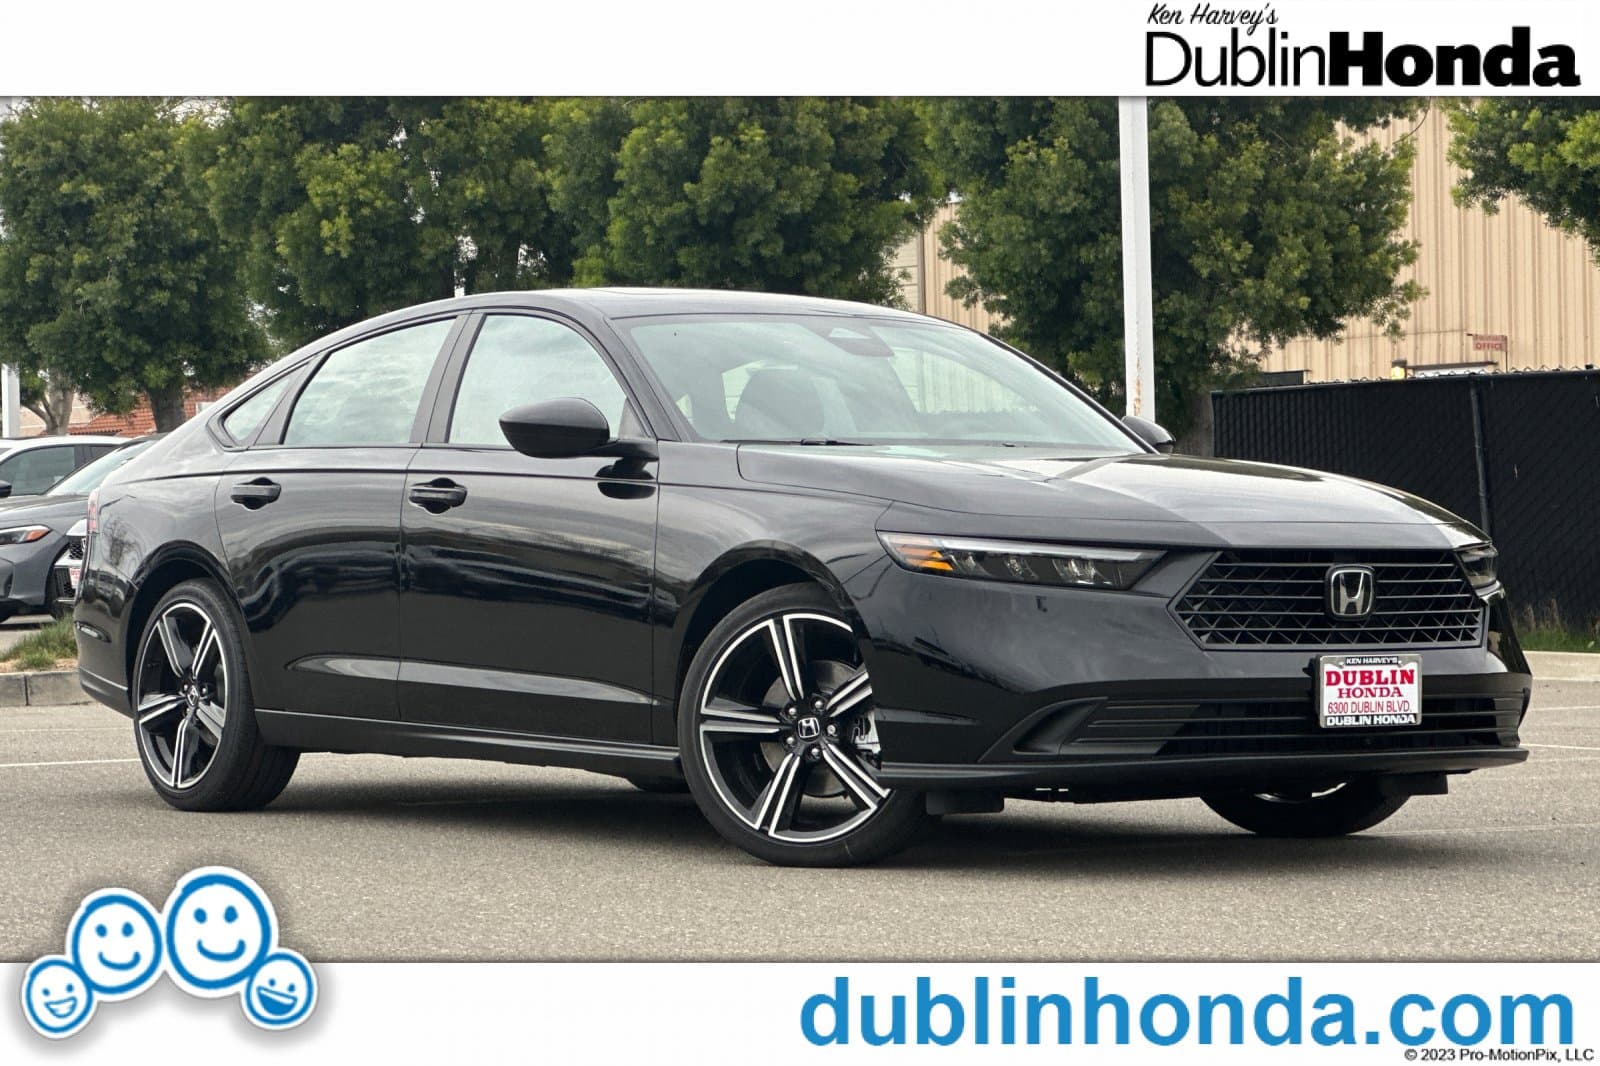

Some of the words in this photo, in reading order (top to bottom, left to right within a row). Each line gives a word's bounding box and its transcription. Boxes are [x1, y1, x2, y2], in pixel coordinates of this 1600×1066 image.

[1346, 657, 1362, 665] KEN
[1363, 656, 1398, 665] HARVEY'S
[1325, 669, 1415, 686] DUBLIN
[1337, 687, 1404, 699] HONDA
[1328, 702, 1349, 714] 6300
[1351, 701, 1385, 714] DUBLIN
[1386, 700, 1412, 713] BLVD.
[1326, 715, 1373, 726] DUBLIN
[1374, 714, 1417, 725] HONDA
